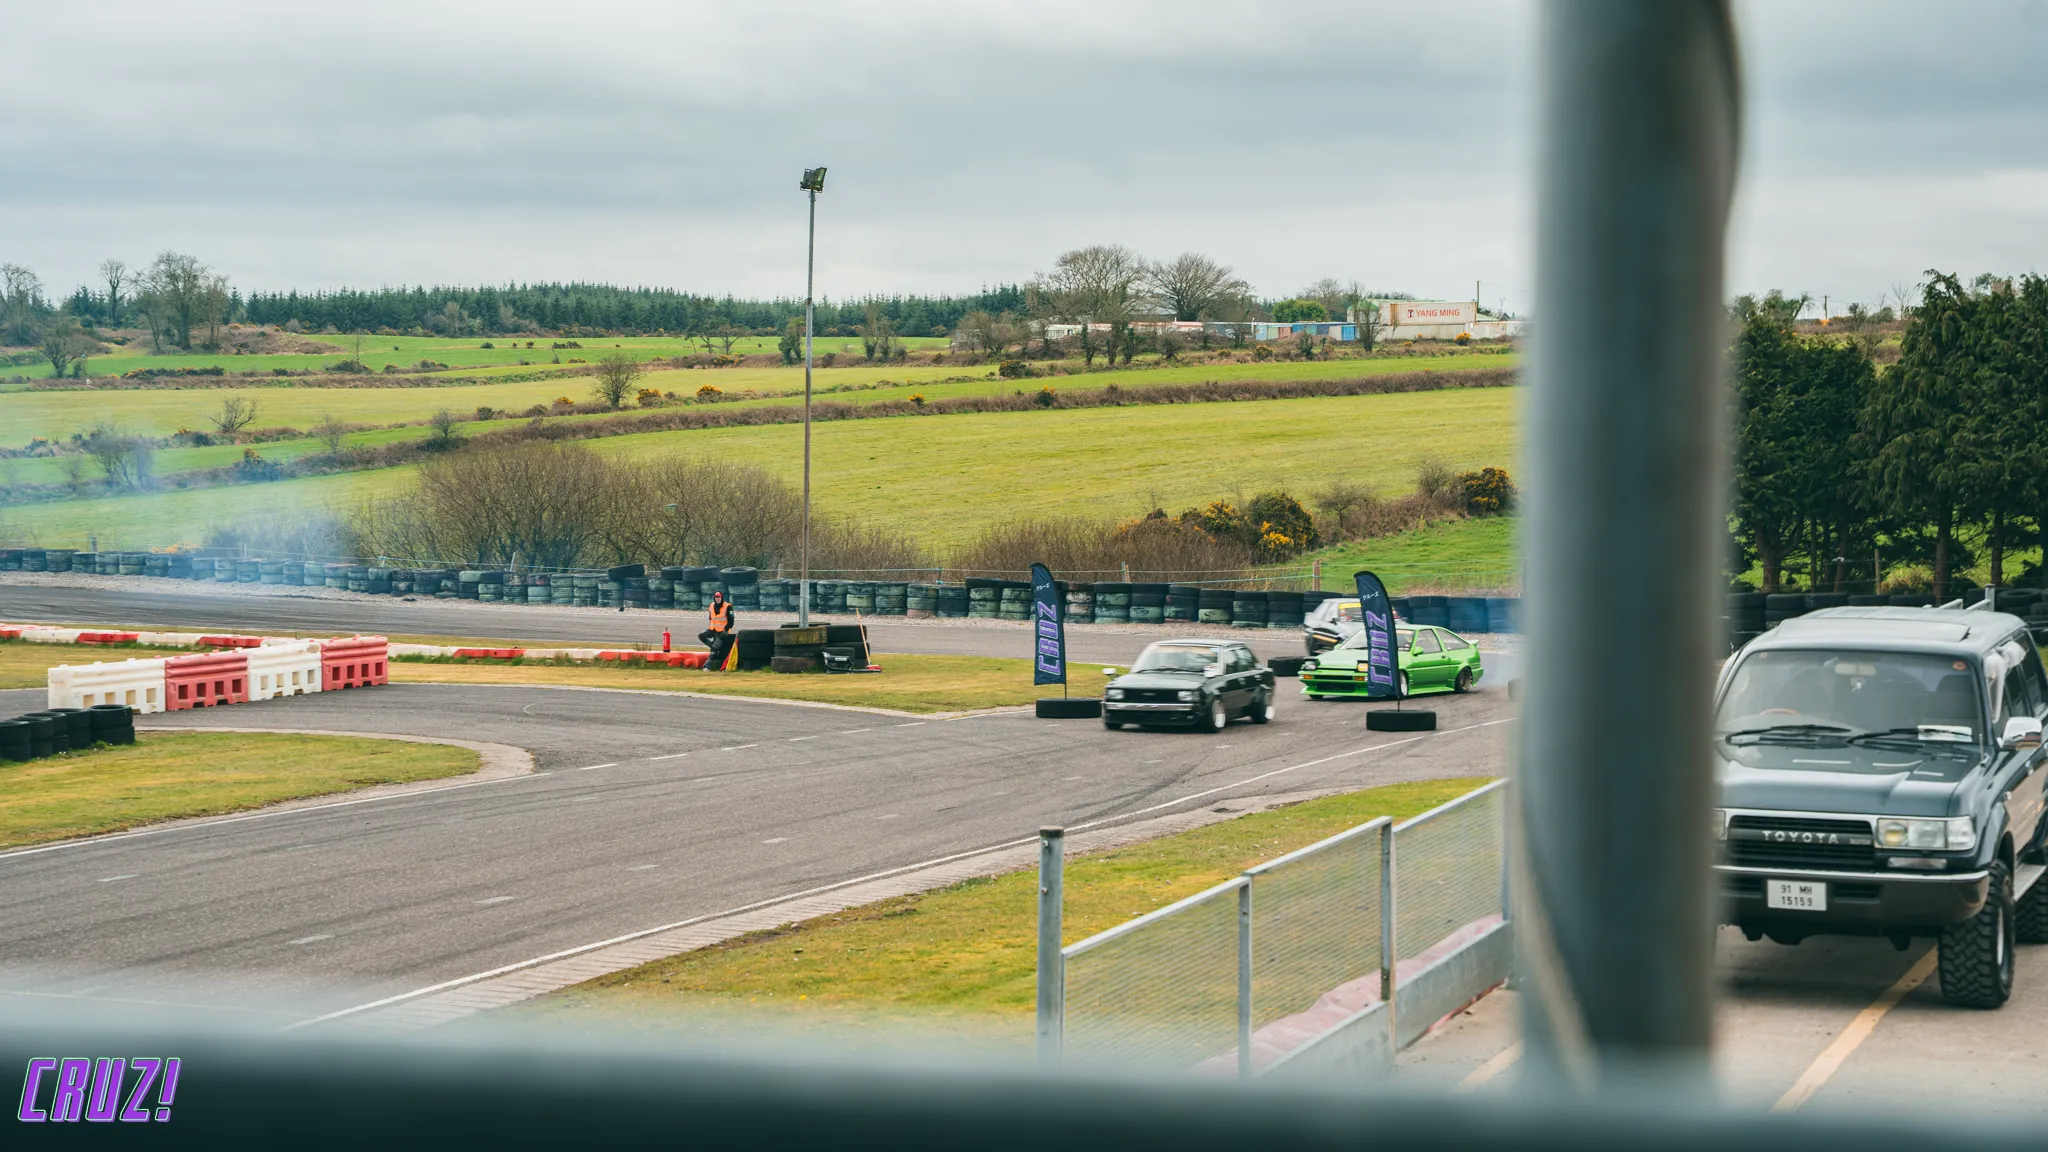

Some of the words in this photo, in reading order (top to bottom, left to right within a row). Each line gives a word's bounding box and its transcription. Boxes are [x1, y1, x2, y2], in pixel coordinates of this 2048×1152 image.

[1416, 309, 1437, 317] YANG
[1037, 601, 1061, 676] CRUZ
[1366, 610, 1393, 686] CRUZ
[1762, 830, 1839, 844] TOYOTA
[1781, 884, 1791, 894] 91
[1800, 885, 1812, 895] MH
[1781, 896, 1812, 907] 15159
